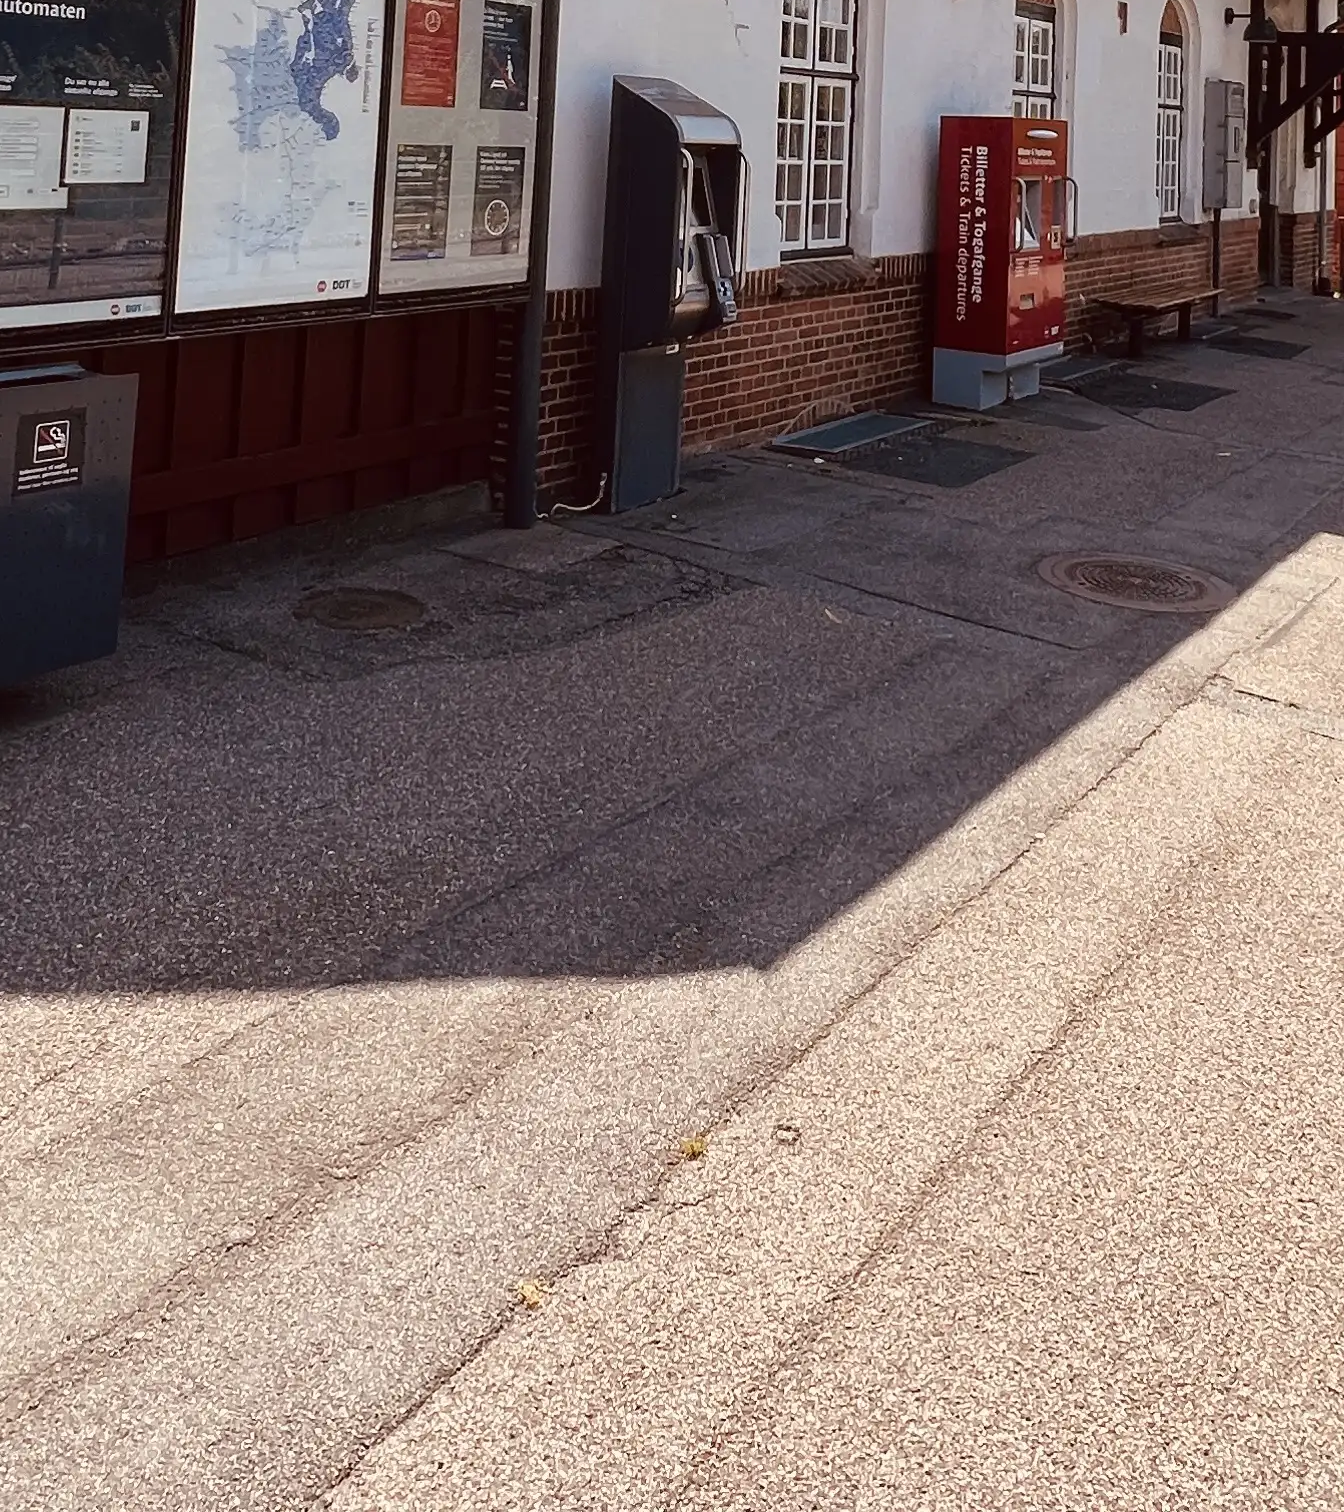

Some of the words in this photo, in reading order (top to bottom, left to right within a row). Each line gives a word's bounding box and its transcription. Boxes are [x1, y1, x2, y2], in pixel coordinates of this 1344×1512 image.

[959, 145, 973, 192] Tickets
[975, 145, 989, 203] Billetter
[959, 197, 972, 207] &
[975, 206, 987, 217] &
[958, 211, 972, 244] Train
[955, 248, 970, 321] departures
[971, 221, 987, 303] Togafgange
